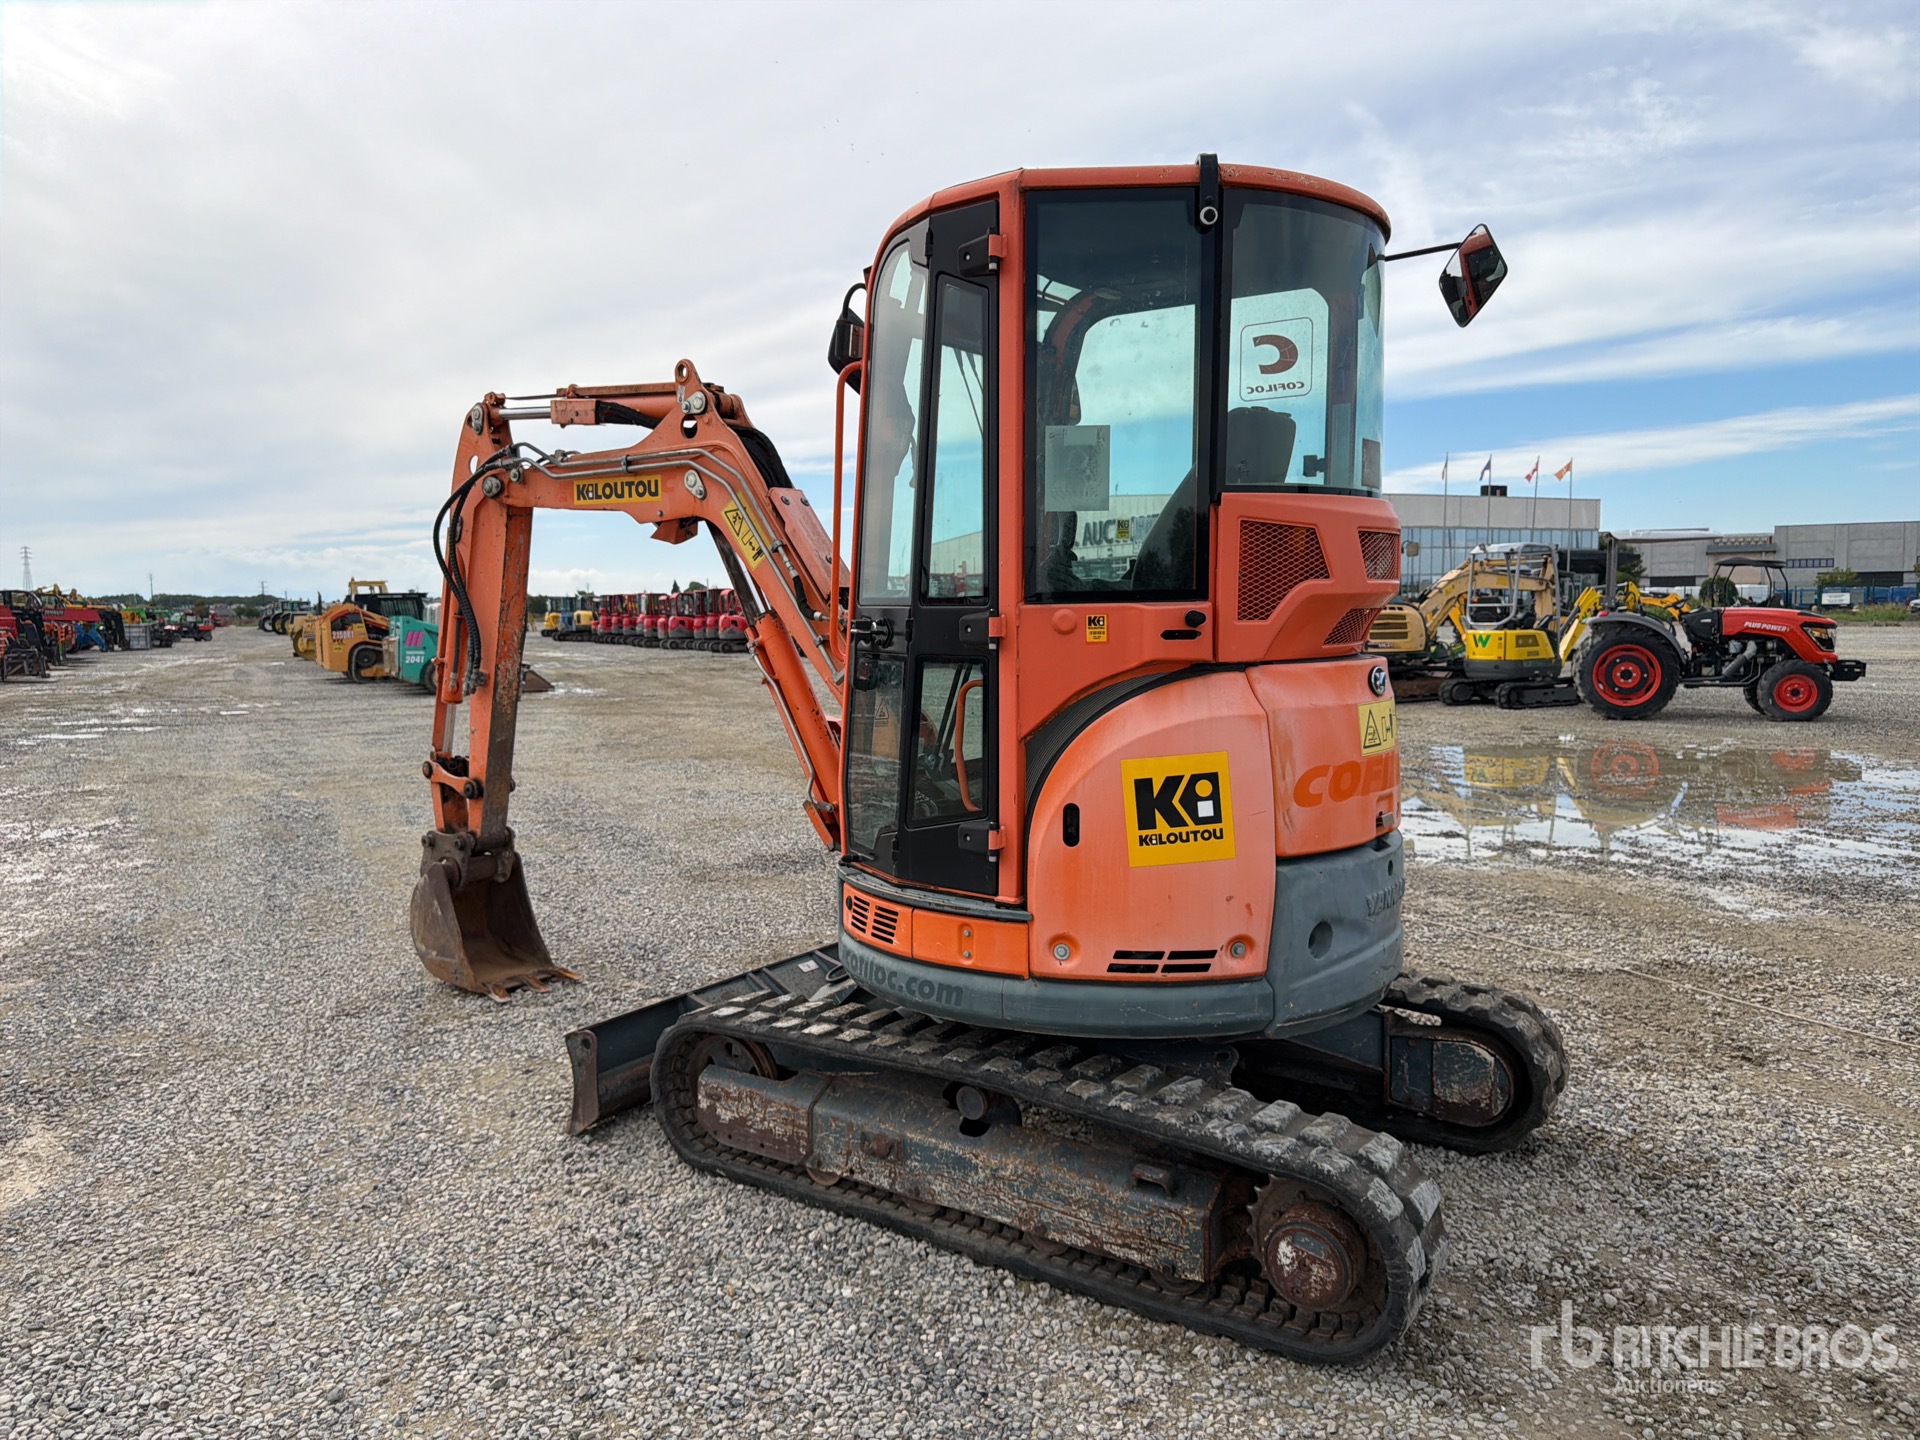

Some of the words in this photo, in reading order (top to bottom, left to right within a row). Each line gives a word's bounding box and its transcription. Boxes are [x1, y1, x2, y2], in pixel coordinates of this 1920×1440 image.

[1744, 621, 1762, 629] PLUS
[1761, 623, 1787, 632] POWER
[405, 655, 425, 664] 2041
